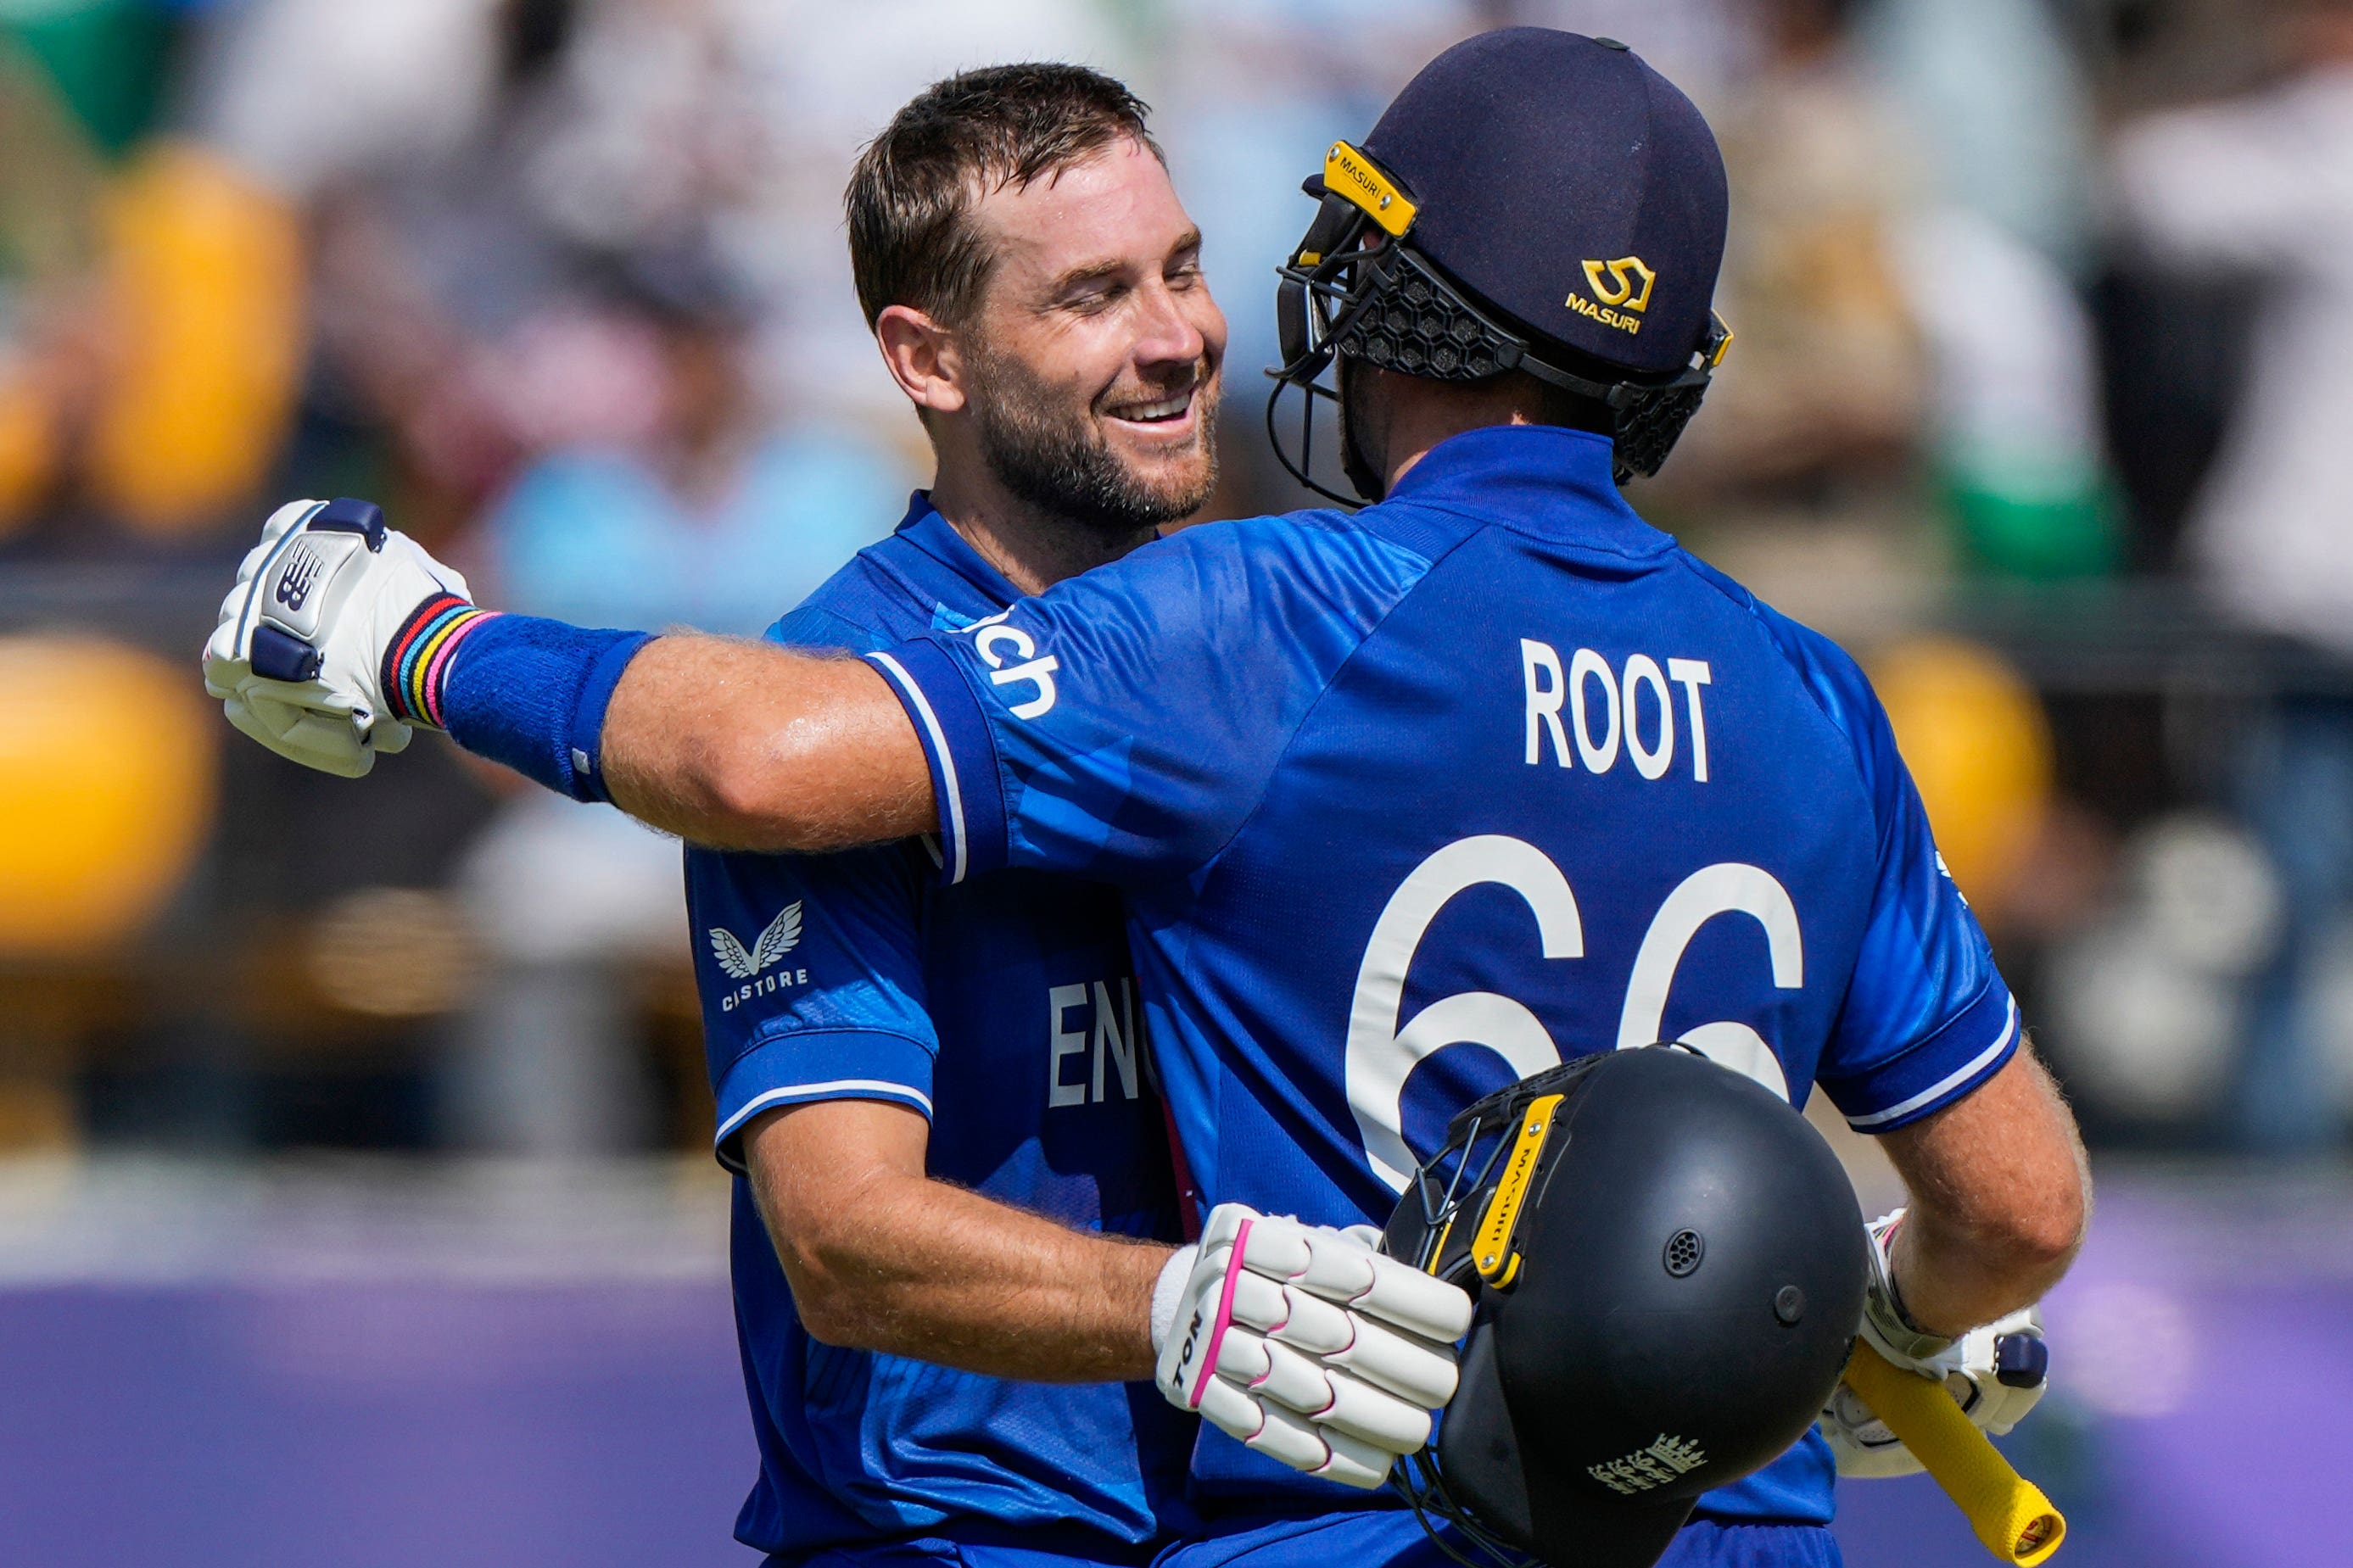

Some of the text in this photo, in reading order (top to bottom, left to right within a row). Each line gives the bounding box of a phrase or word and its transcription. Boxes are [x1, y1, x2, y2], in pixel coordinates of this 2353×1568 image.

[1340, 157, 1381, 198] MASURI
[1564, 293, 1641, 335] MASURI
[1520, 638, 1712, 783] ROOT
[1048, 977, 1157, 1108] EN
[1344, 834, 1804, 1196] 66
[1172, 1309, 1203, 1390] TON
